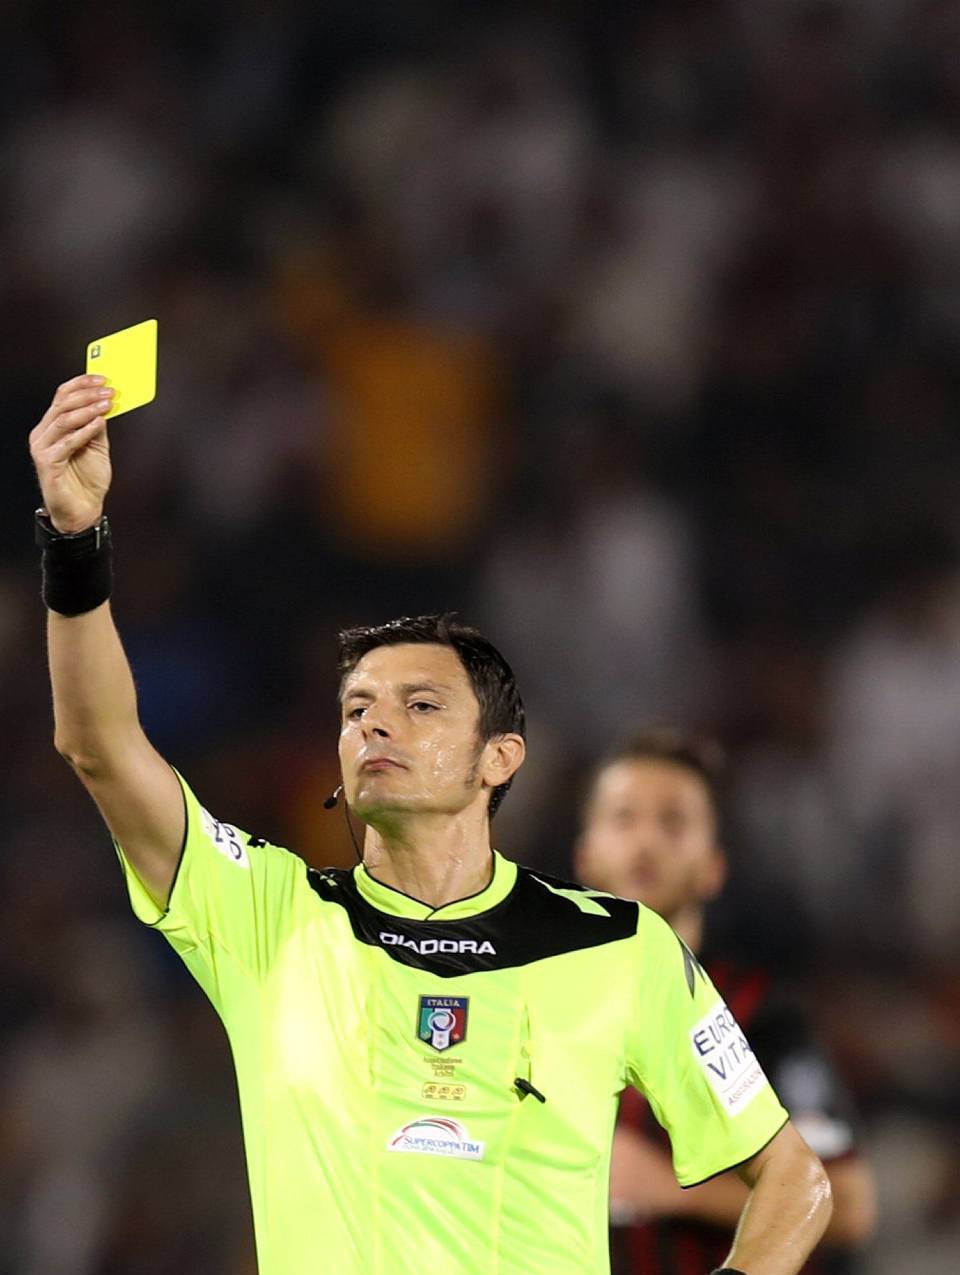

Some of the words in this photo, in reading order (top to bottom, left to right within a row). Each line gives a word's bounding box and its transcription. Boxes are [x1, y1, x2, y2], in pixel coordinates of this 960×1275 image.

[379, 931, 497, 955] DIADORA
[427, 999, 460, 1007] ITALIA
[693, 1006, 737, 1056] EURO
[707, 1036, 754, 1080] VITA
